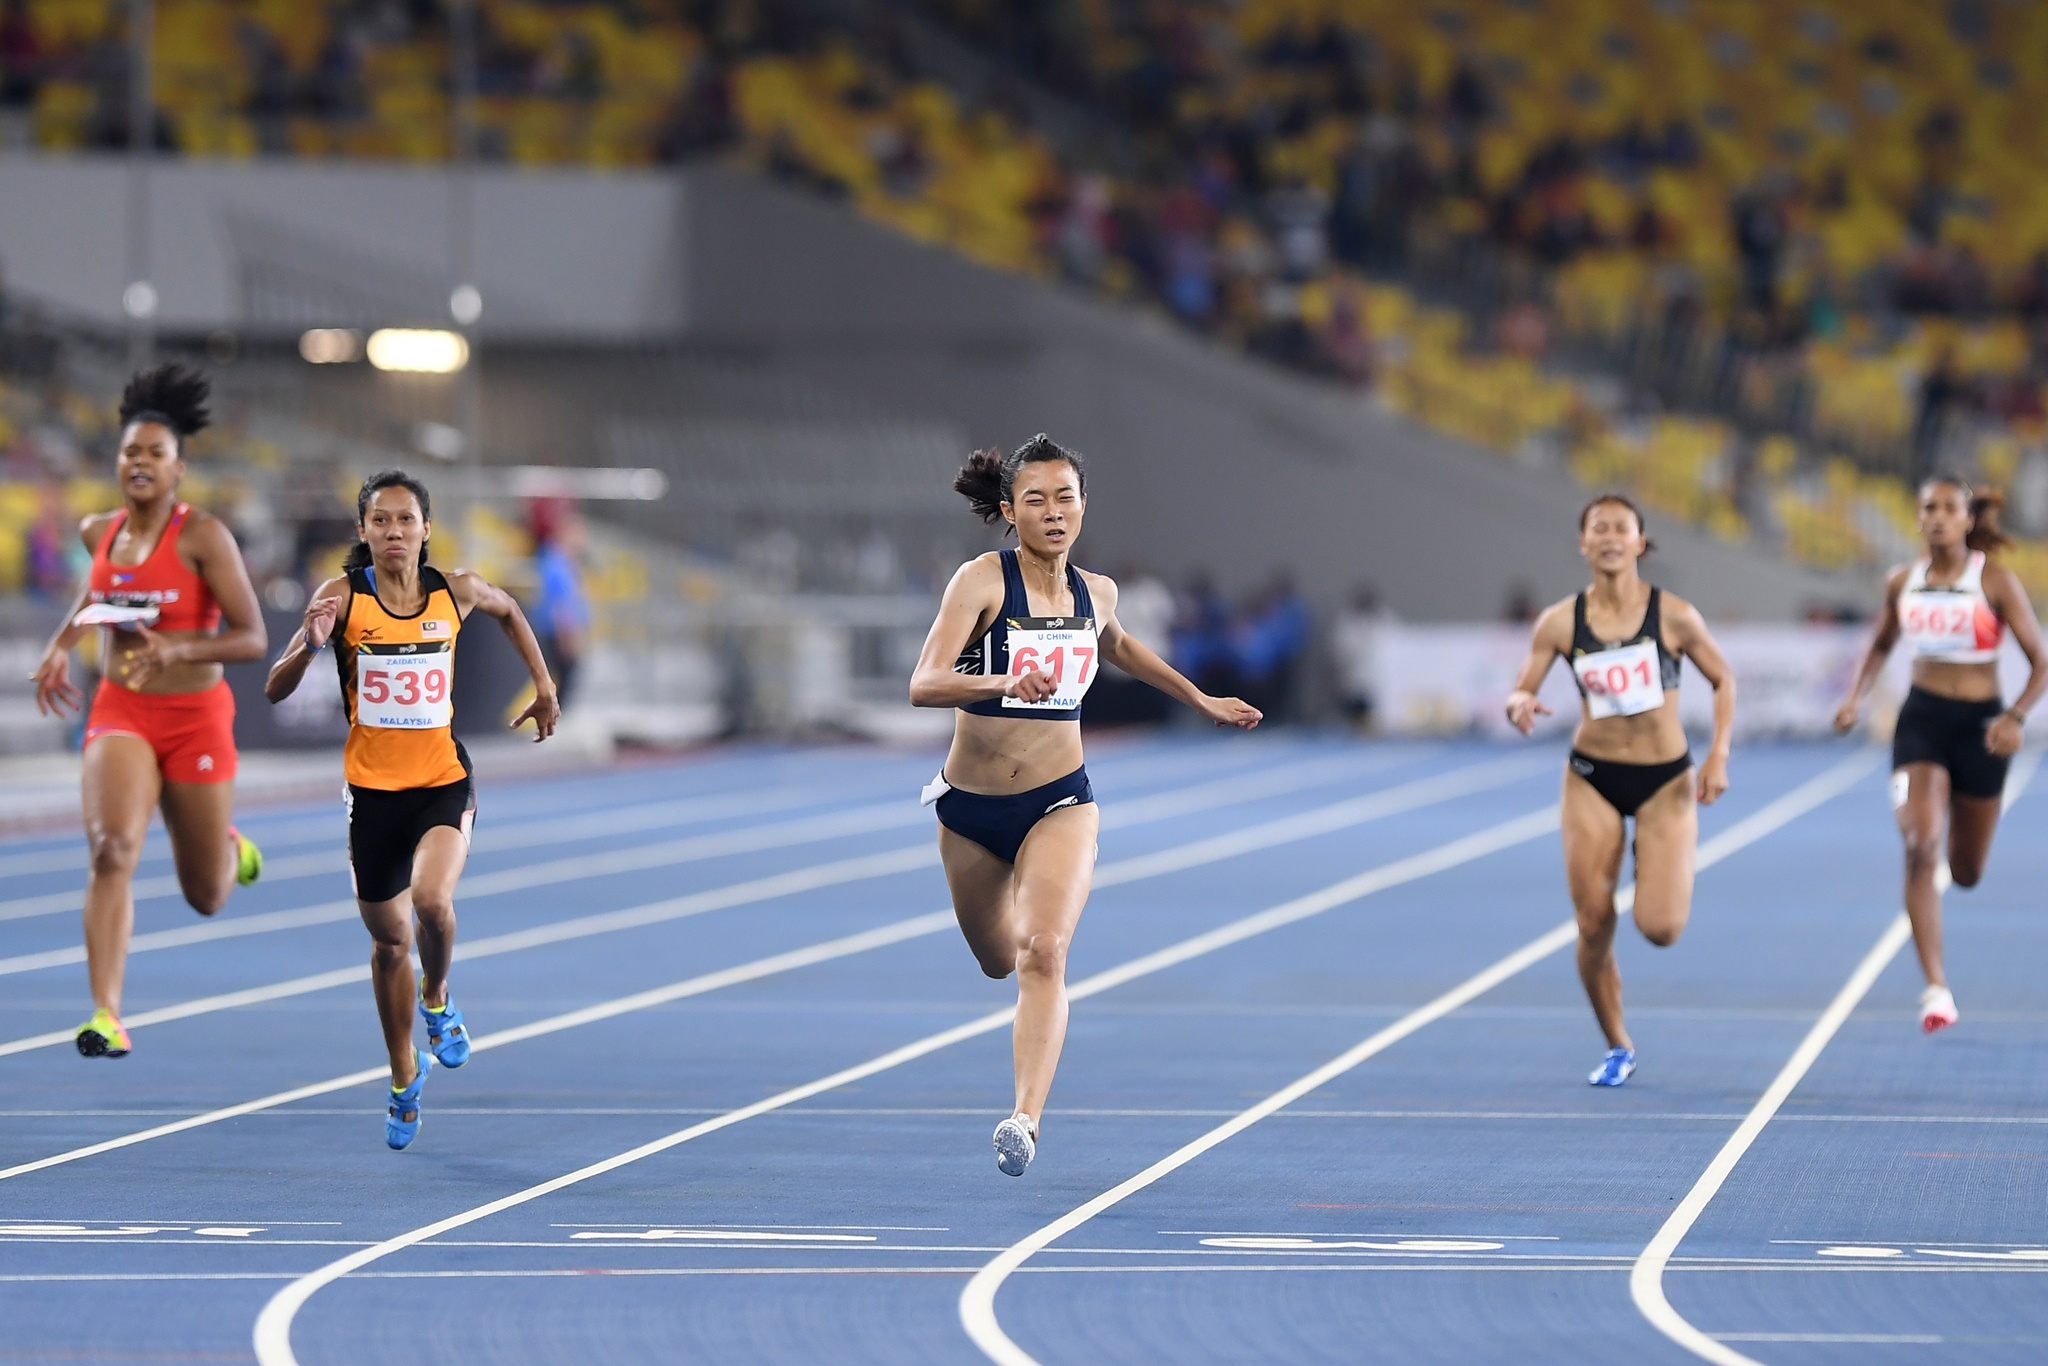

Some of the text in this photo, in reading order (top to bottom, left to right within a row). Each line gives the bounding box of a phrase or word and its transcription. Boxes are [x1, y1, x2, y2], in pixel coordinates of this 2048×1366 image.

[386, 658, 429, 666] ZAIDATUL
[1012, 646, 1094, 684] 617
[1582, 659, 1652, 696] 601
[362, 668, 447, 706] 539
[380, 717, 433, 726] MALAYSIA
